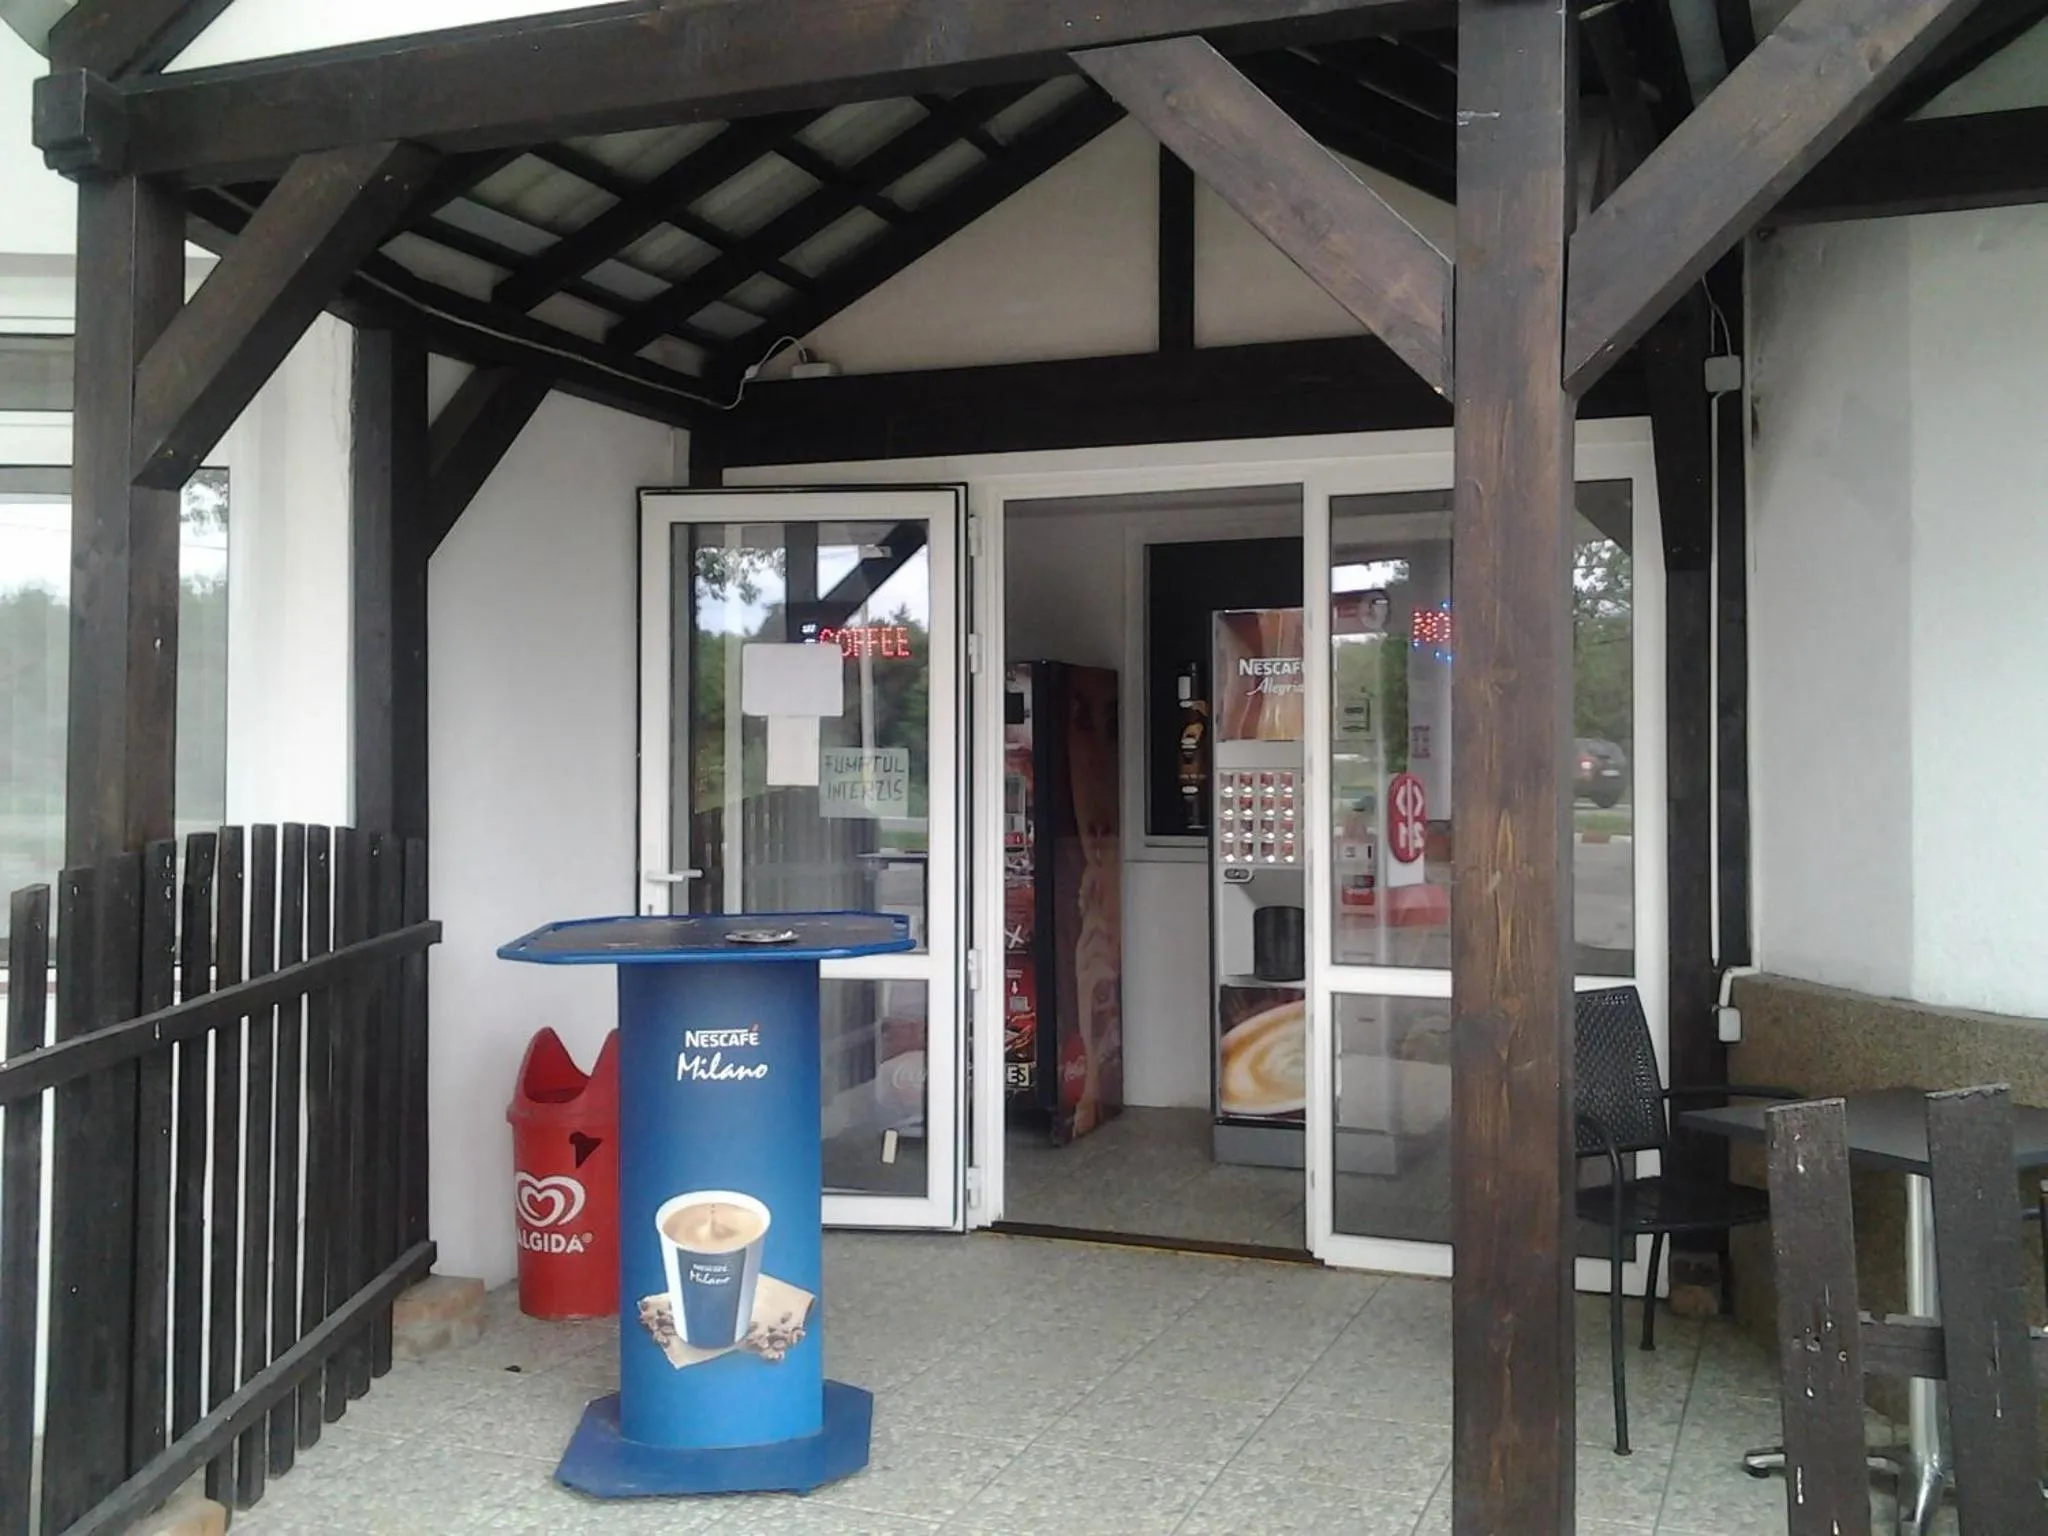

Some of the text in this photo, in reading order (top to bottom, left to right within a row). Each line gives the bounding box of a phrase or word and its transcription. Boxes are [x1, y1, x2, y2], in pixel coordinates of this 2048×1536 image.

[819, 626, 910, 656] COFFEE
[1239, 657, 1304, 676] NESCAF
[685, 1024, 759, 1048] NESCAFÉ
[677, 1051, 768, 1081] Milano
